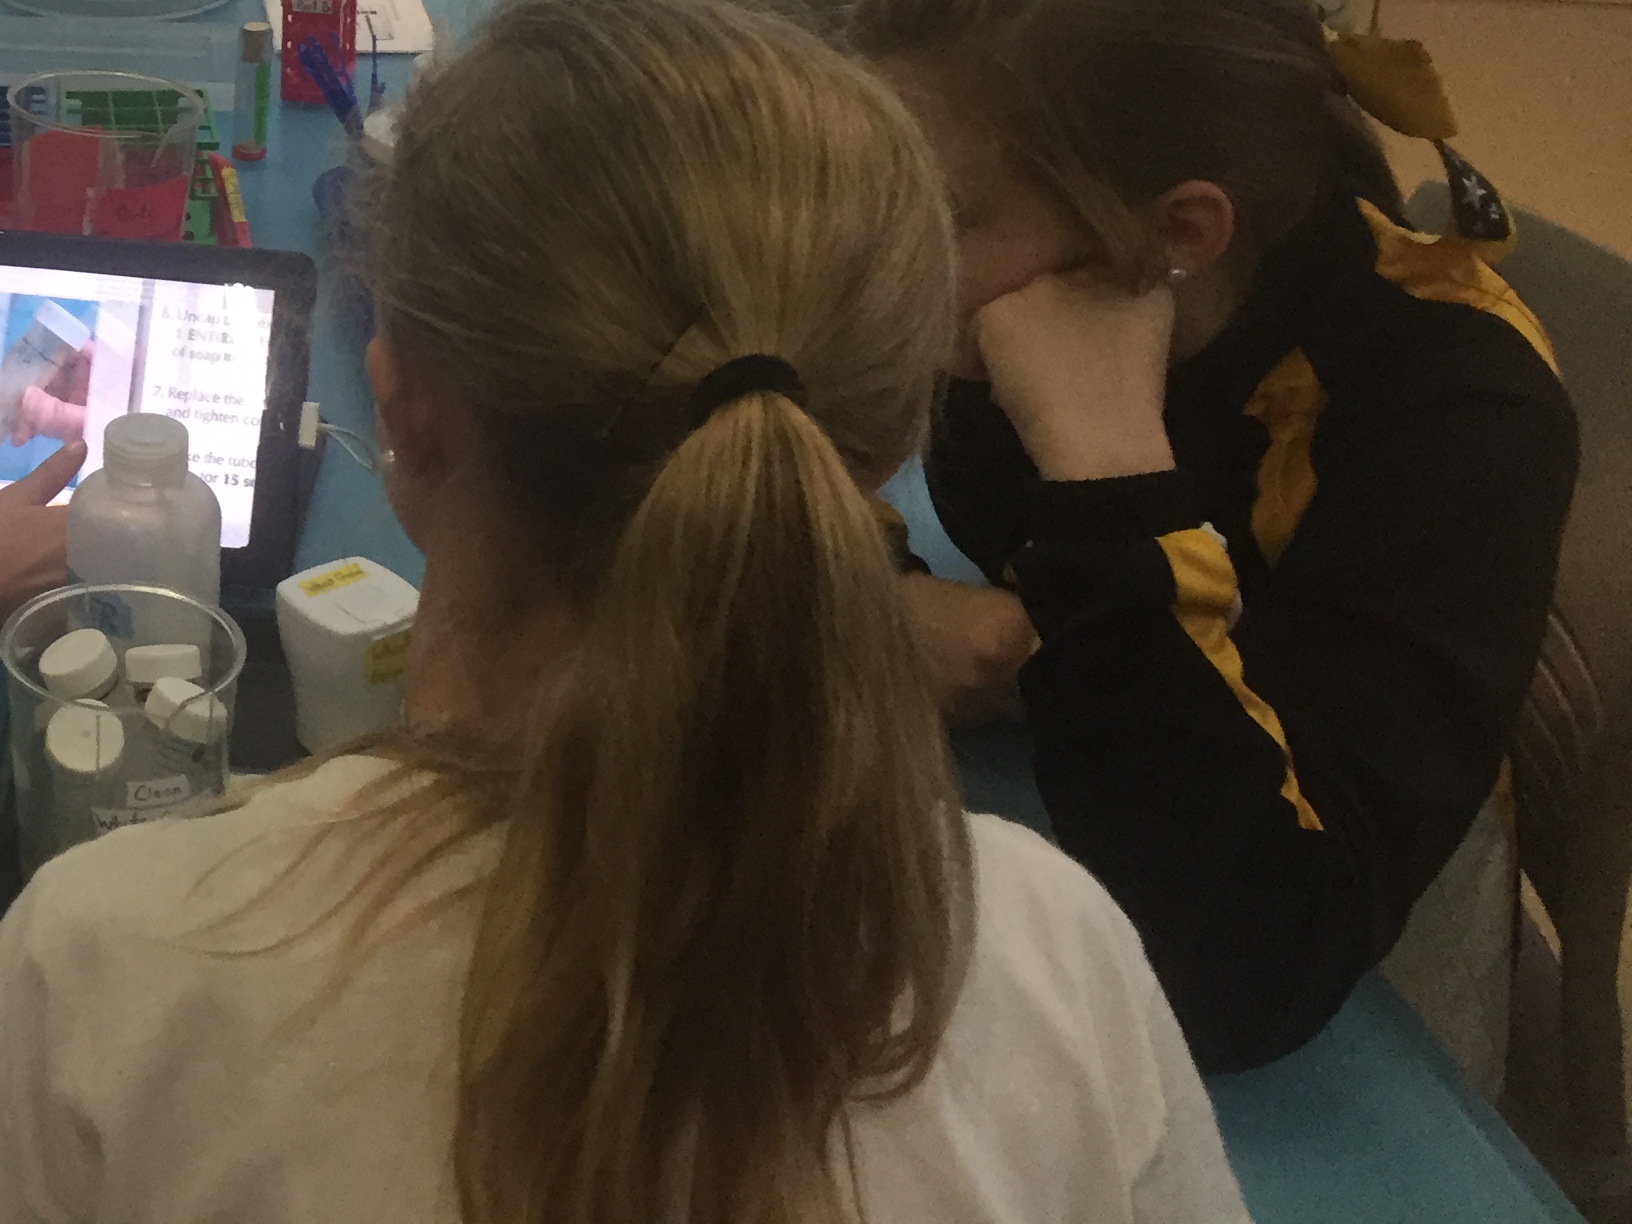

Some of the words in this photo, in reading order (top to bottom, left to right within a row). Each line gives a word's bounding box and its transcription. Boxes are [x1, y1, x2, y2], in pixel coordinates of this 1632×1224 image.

[172, 345, 185, 358] of
[188, 349, 222, 365] soap
[167, 386, 221, 404] Replace
[223, 392, 245, 406] the
[165, 406, 191, 420] and
[194, 408, 239, 426] tighten
[204, 450, 225, 465] the
[223, 472, 239, 487] 15
[133, 784, 183, 803] Clean
